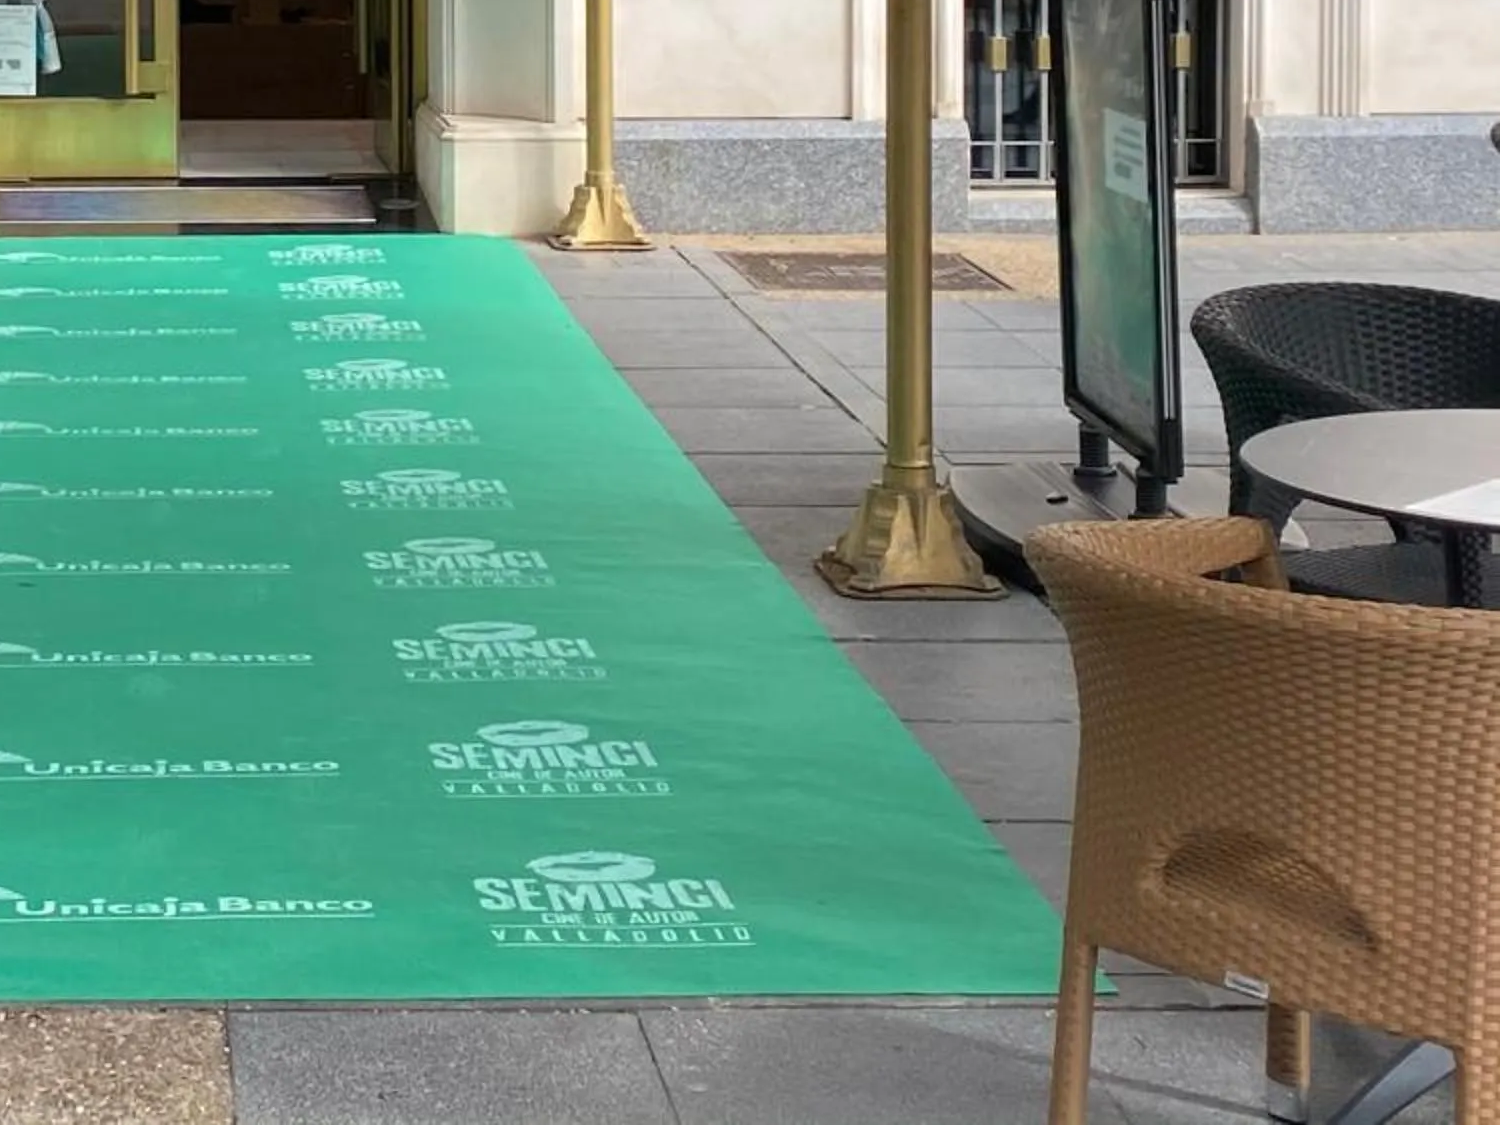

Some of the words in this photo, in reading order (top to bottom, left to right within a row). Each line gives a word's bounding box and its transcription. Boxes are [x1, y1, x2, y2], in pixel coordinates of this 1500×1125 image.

[339, 479, 508, 496] SEMINCI
[36, 560, 173, 572] Unicaja
[180, 561, 291, 571] Banco
[362, 551, 548, 570] SEMINCI
[31, 651, 182, 664] Unicaja
[190, 651, 313, 662] Banco
[392, 638, 597, 660] SEMINCI
[427, 740, 658, 770] SEMINCI
[24, 759, 197, 776] Unicaja
[203, 760, 340, 773] Banco
[472, 878, 735, 911] SEMINCI
[15, 897, 208, 917] Unicaja
[217, 897, 373, 913] Banco
[492, 926, 750, 942] VALLADOLID
